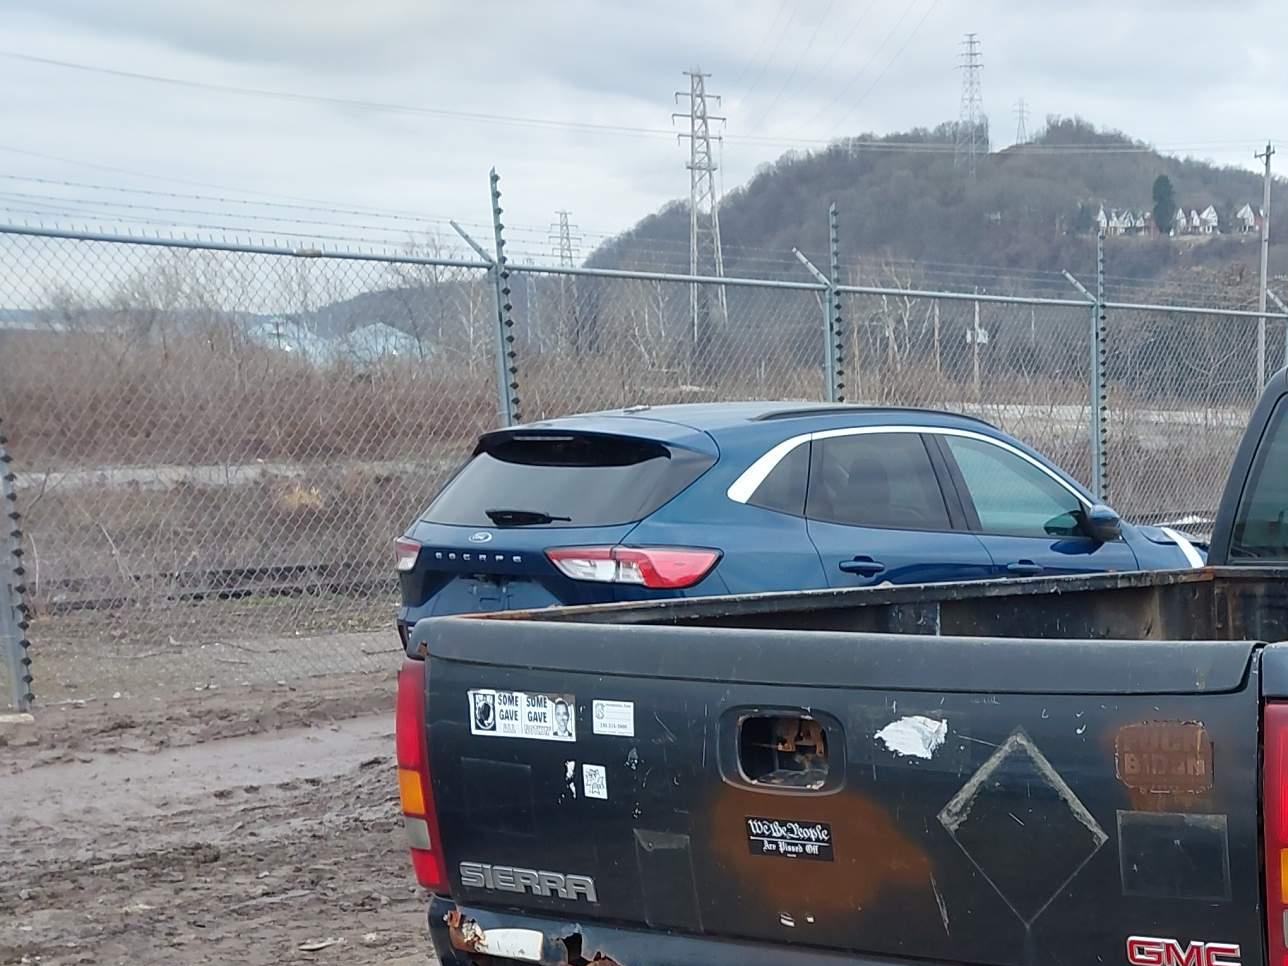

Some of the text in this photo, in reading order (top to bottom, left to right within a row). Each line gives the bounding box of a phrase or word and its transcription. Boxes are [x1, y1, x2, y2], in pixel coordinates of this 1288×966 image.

[497, 693, 519, 707] SOME
[526, 696, 548, 708] SOME
[499, 709, 519, 721] GAVE
[527, 711, 548, 723] GAVE
[747, 819, 772, 835] We
[786, 823, 830, 841] People
[763, 840, 819, 855] Are Pissed Off
[459, 861, 597, 902] SIERRA
